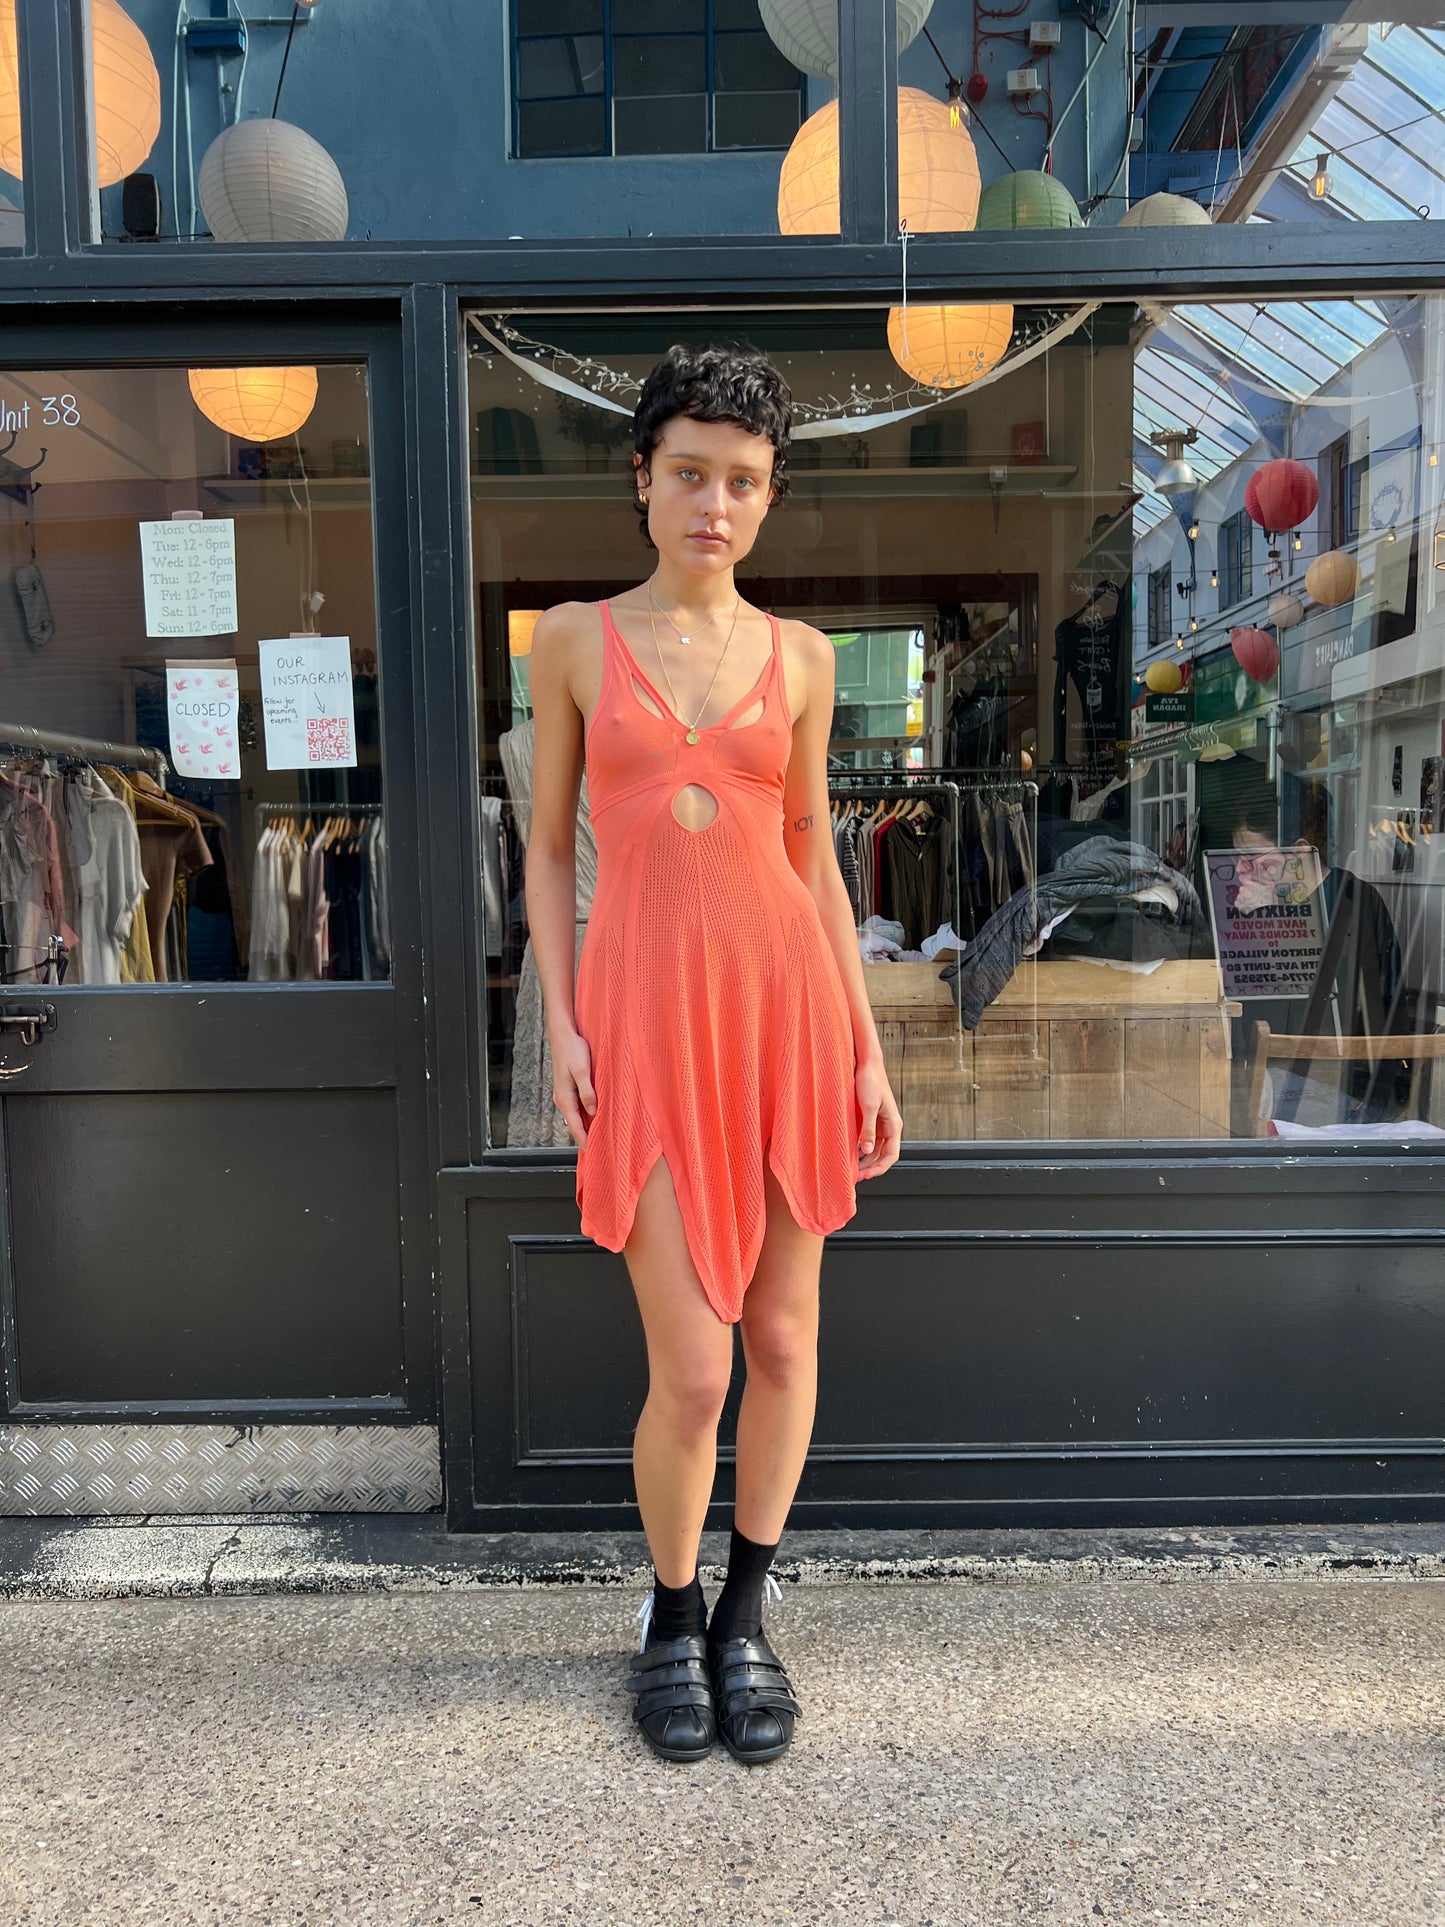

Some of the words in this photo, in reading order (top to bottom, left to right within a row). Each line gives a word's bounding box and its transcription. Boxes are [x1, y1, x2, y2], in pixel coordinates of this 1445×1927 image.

[42, 394, 80, 426] 38
[154, 524, 184, 535] Mon:
[188, 523, 227, 534] Closed
[153, 541, 180, 552] Tue:
[183, 539, 197, 551] 12
[205, 539, 230, 552] 6pm
[152, 558, 184, 568] Wed:
[188, 556, 200, 567] 12
[210, 555, 233, 568] 6pm
[150, 574, 180, 584] Thu:
[188, 572, 200, 584] 12
[210, 571, 233, 585] 7pm
[161, 590, 181, 600] Fri:
[186, 588, 198, 600] 12
[208, 589, 231, 602] 7pm
[162, 606, 183, 617] Sat:
[188, 606, 198, 616] 11
[210, 605, 232, 618] 7pm
[158, 623, 184, 633] Sun:
[188, 622, 200, 633] 12
[211, 622, 234, 634] 6pm
[277, 656, 305, 668] OUR
[273, 671, 348, 686] INSTAGRAM
[176, 702, 230, 717] CLOSED
[285, 697, 295, 709] for
[266, 708, 298, 718] upcoming
